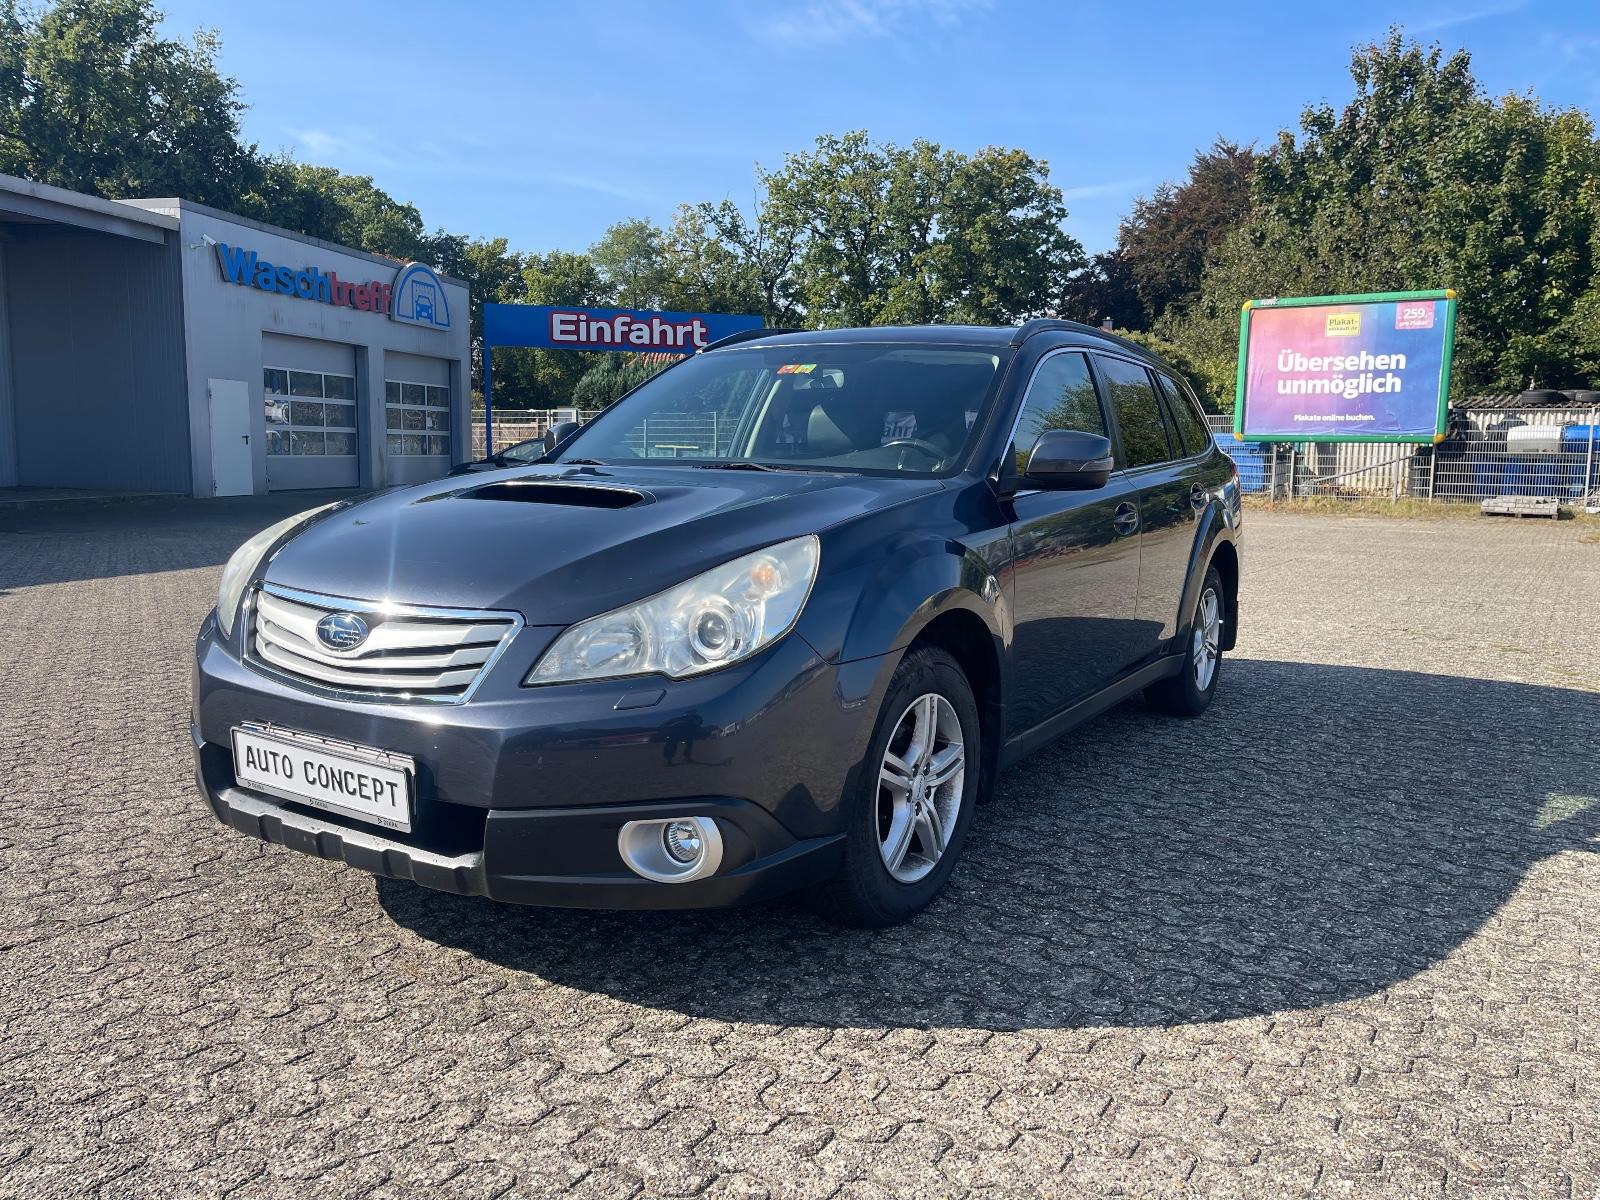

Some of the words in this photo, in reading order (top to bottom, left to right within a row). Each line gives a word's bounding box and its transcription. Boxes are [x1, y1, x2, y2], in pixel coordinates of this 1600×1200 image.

[217, 243, 392, 315] Waschtreff
[552, 313, 708, 347] Einfahrt
[1277, 349, 1406, 372] Übersehen
[1277, 373, 1402, 399] unmöglich
[1293, 413, 1321, 421] Plakate
[1346, 413, 1375, 421] buchen.
[246, 745, 294, 779] AUTO
[303, 760, 399, 807] CONCEPT
